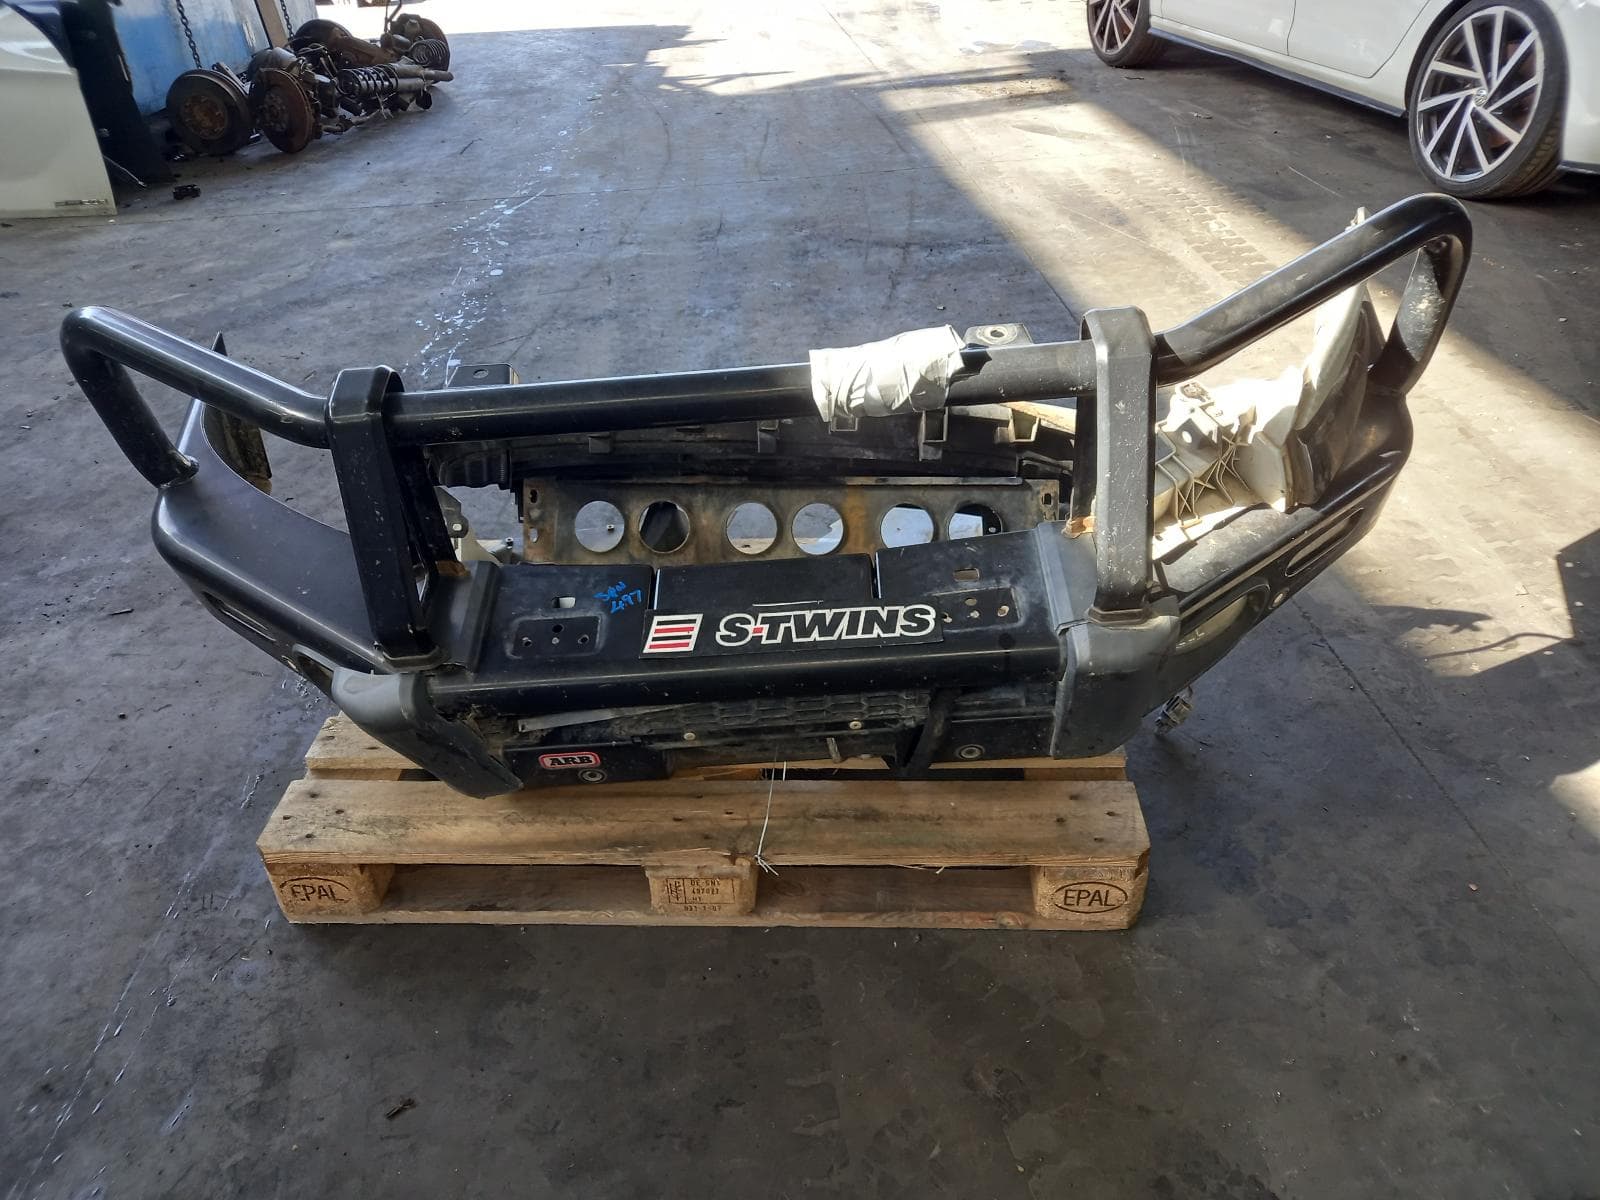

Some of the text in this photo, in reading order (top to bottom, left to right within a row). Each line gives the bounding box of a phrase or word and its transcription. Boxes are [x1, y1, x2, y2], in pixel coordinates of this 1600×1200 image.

[549, 755, 593, 766] ARB
[291, 884, 344, 901] EPAL
[1063, 889, 1116, 907] EPAL
